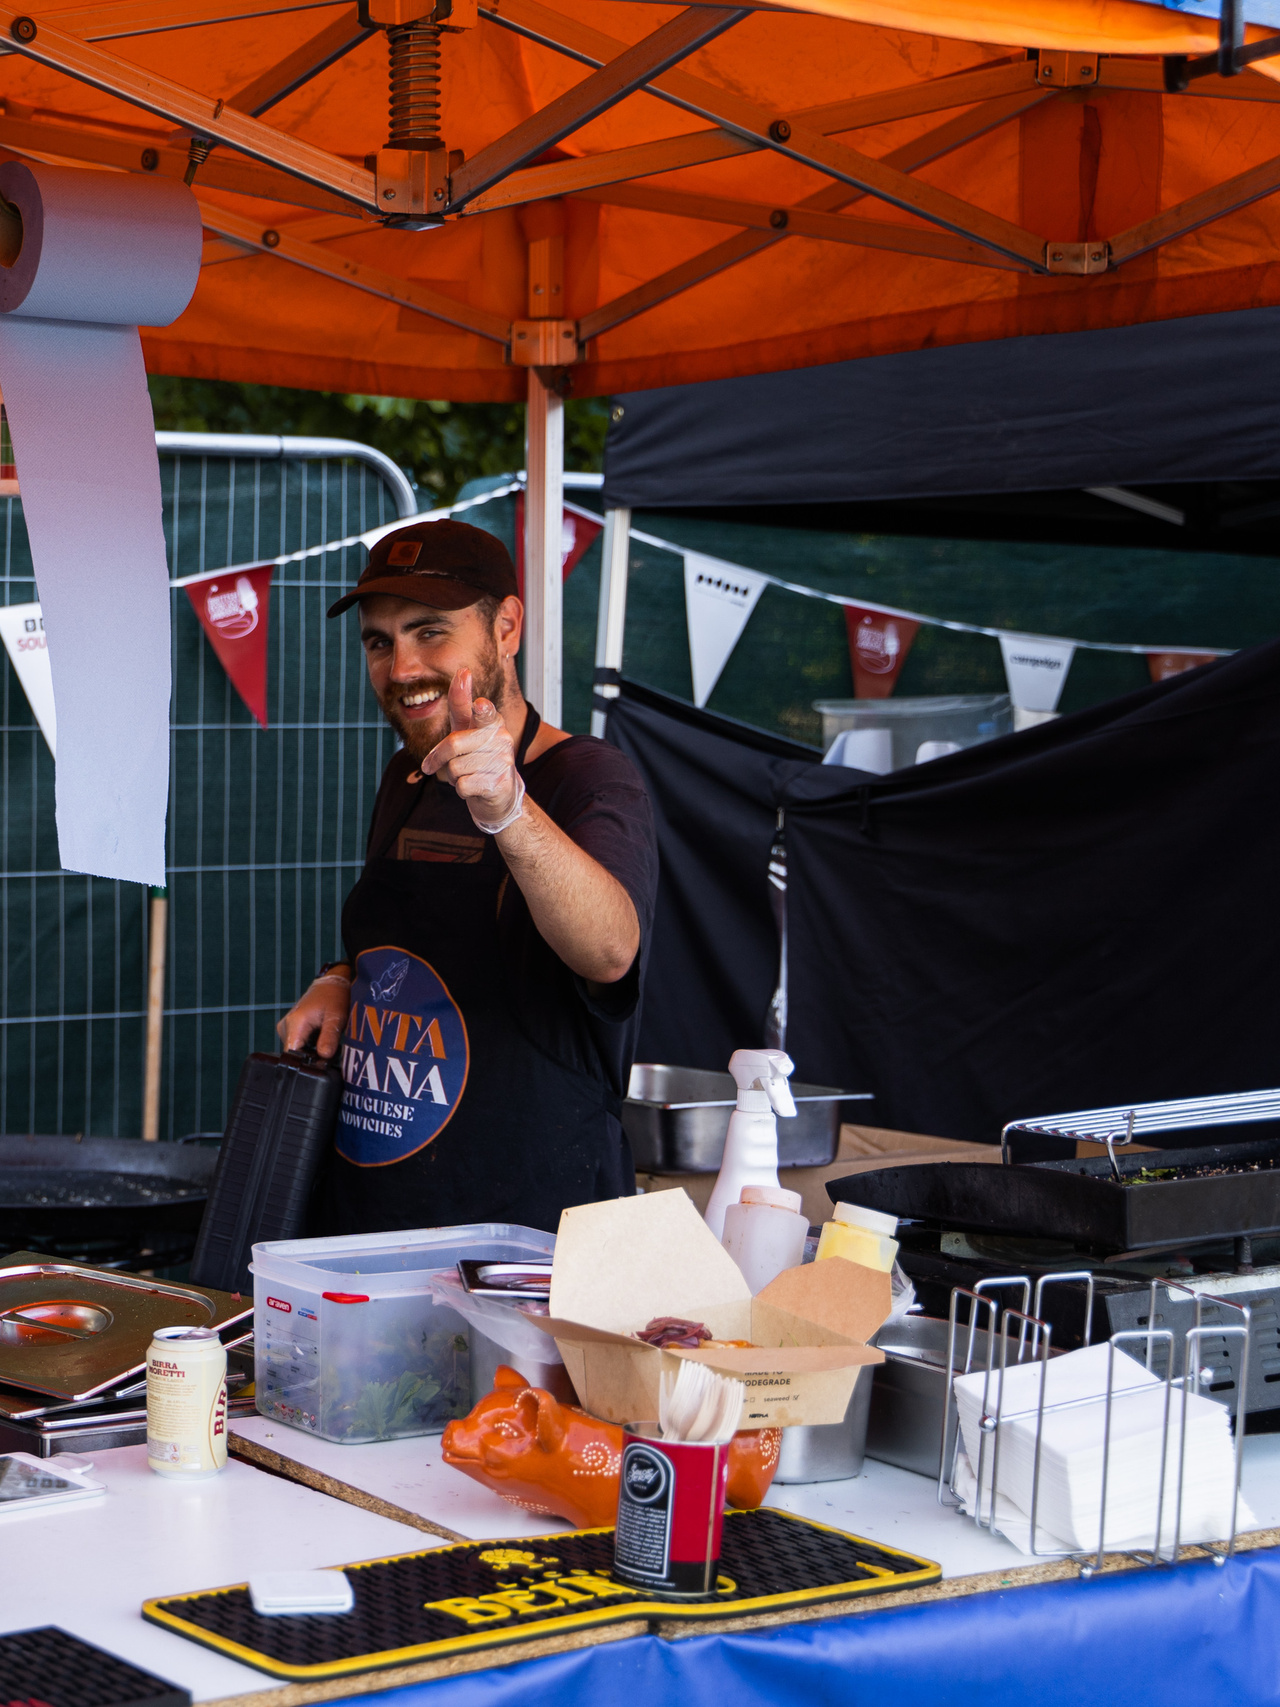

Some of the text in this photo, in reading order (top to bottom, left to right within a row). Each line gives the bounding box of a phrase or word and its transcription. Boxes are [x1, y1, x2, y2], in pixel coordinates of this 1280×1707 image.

[268, 1299, 290, 1311] araven
[152, 1359, 178, 1370] BIRRA
[149, 1366, 185, 1378] MORETTI
[738, 1379, 791, 1387] ODEGRADE
